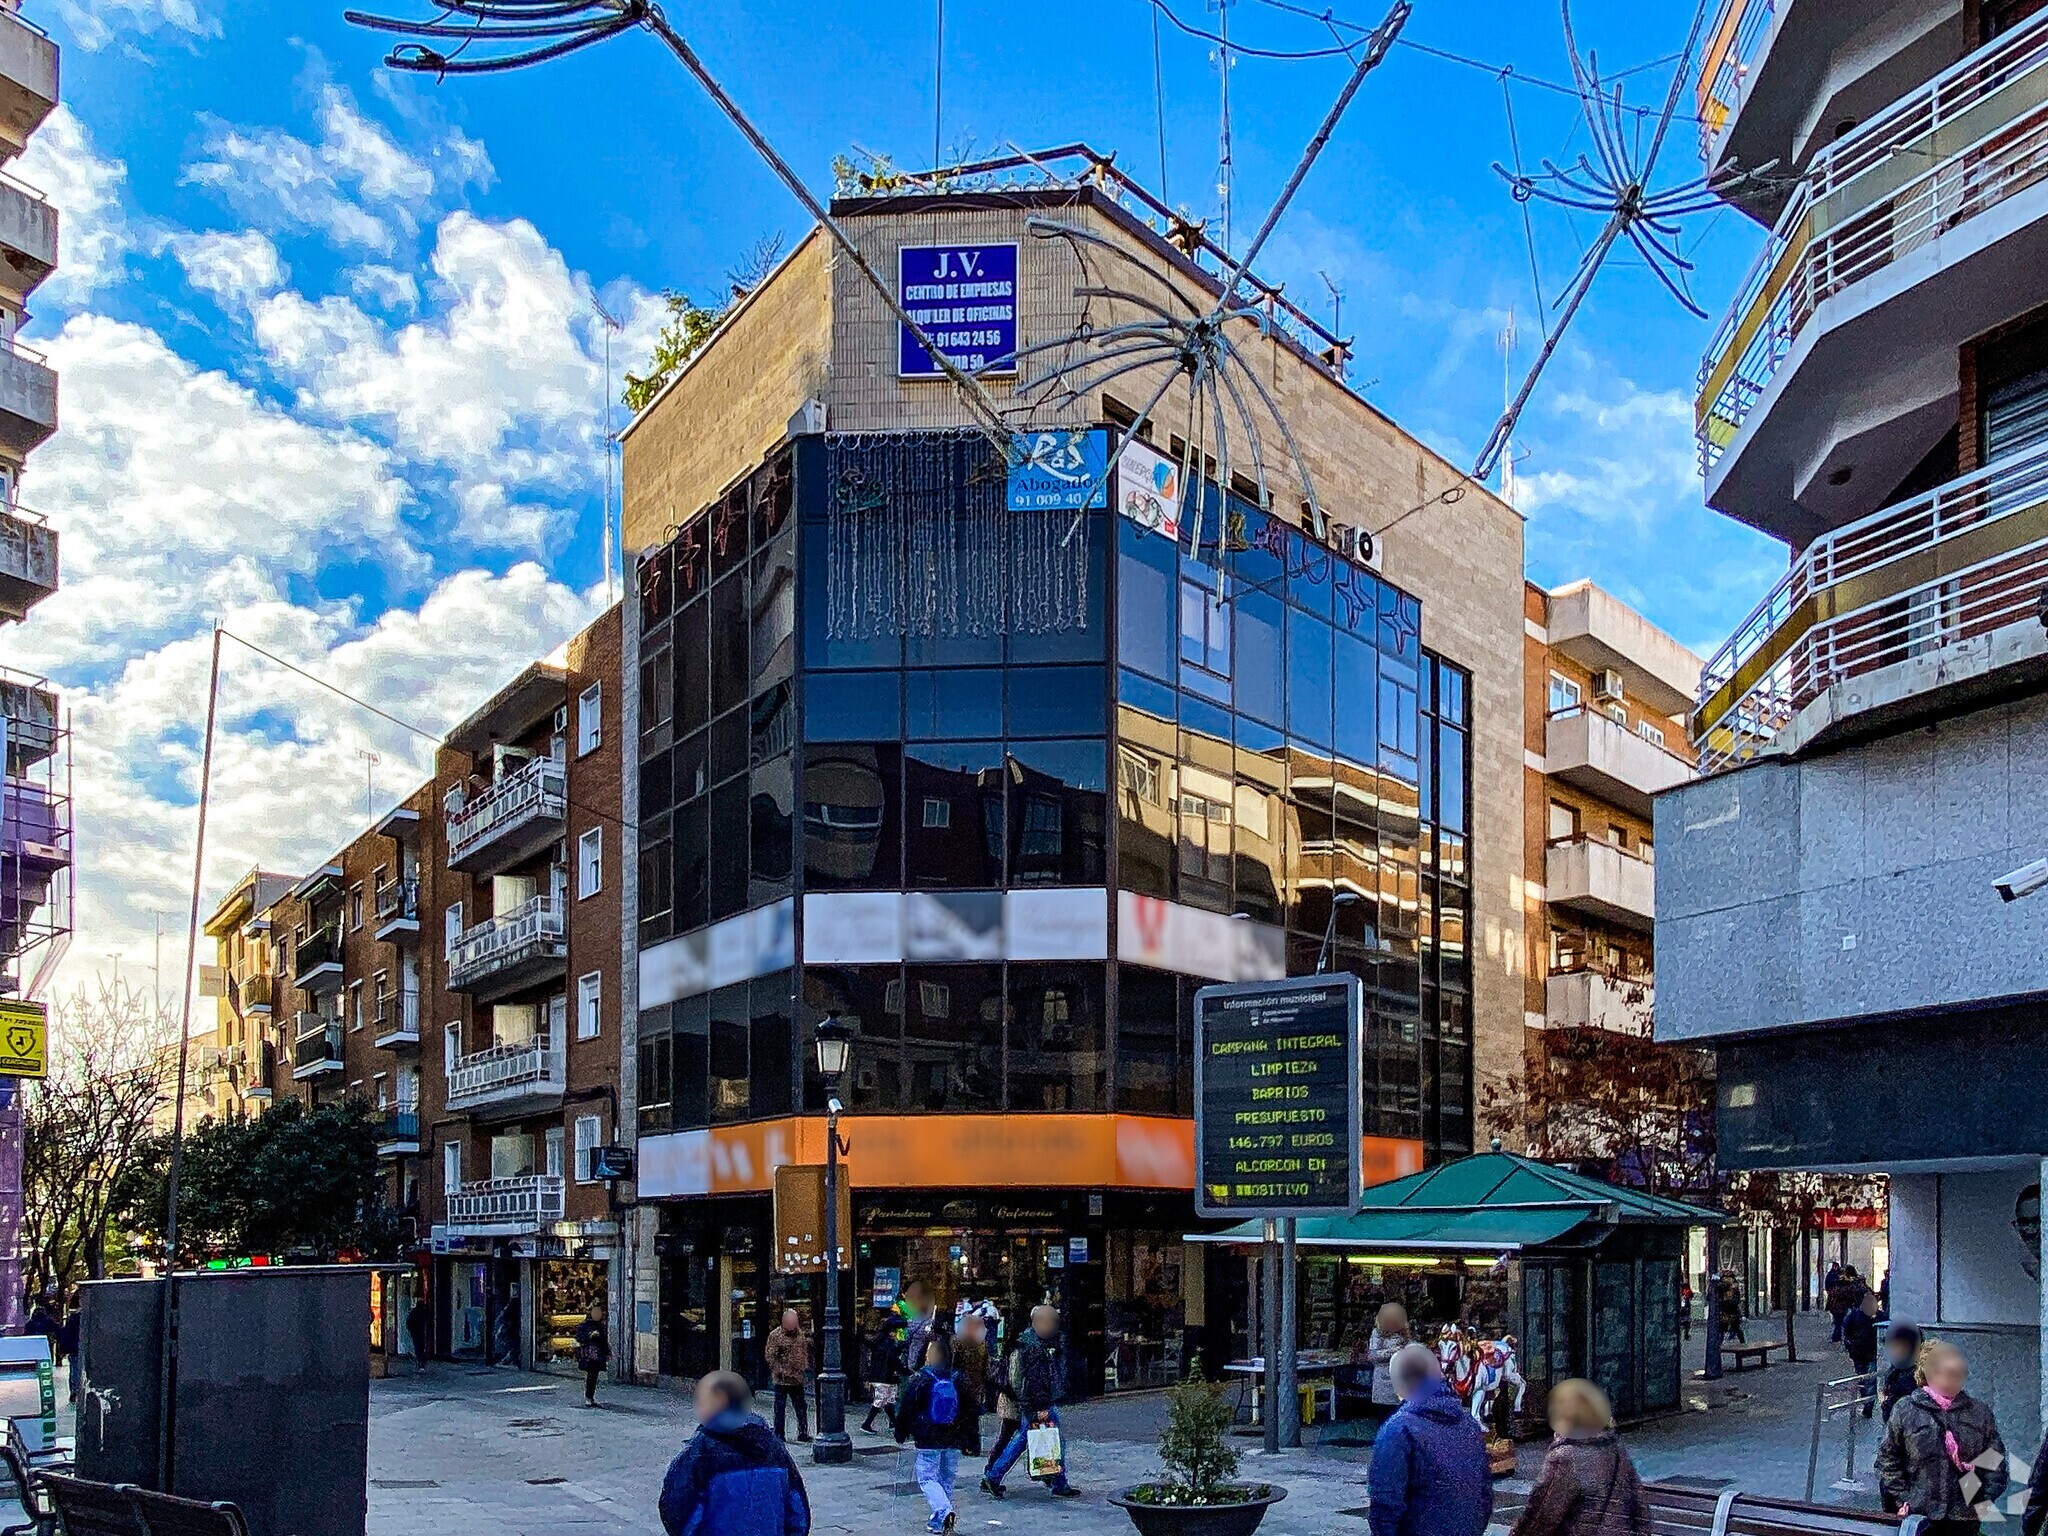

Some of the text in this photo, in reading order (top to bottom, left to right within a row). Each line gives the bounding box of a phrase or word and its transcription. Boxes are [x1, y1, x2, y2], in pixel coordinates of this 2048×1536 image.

[933, 251, 984, 278] J.V.
[905, 281, 1012, 301] CENTRO DE EMPRESAS
[952, 308, 965, 323] DE
[966, 305, 1013, 322] OFICINAS
[1276, 1035, 1342, 1052] INTEGRAL
[1251, 1060, 1317, 1077] LIMPIEZA
[1251, 1085, 1309, 1101] BARRIOS
[1235, 1108, 1326, 1125] PRESUPUESTO
[1291, 1132, 1335, 1147] EUROS
[1235, 1157, 1326, 1173] ALCORCON EN
